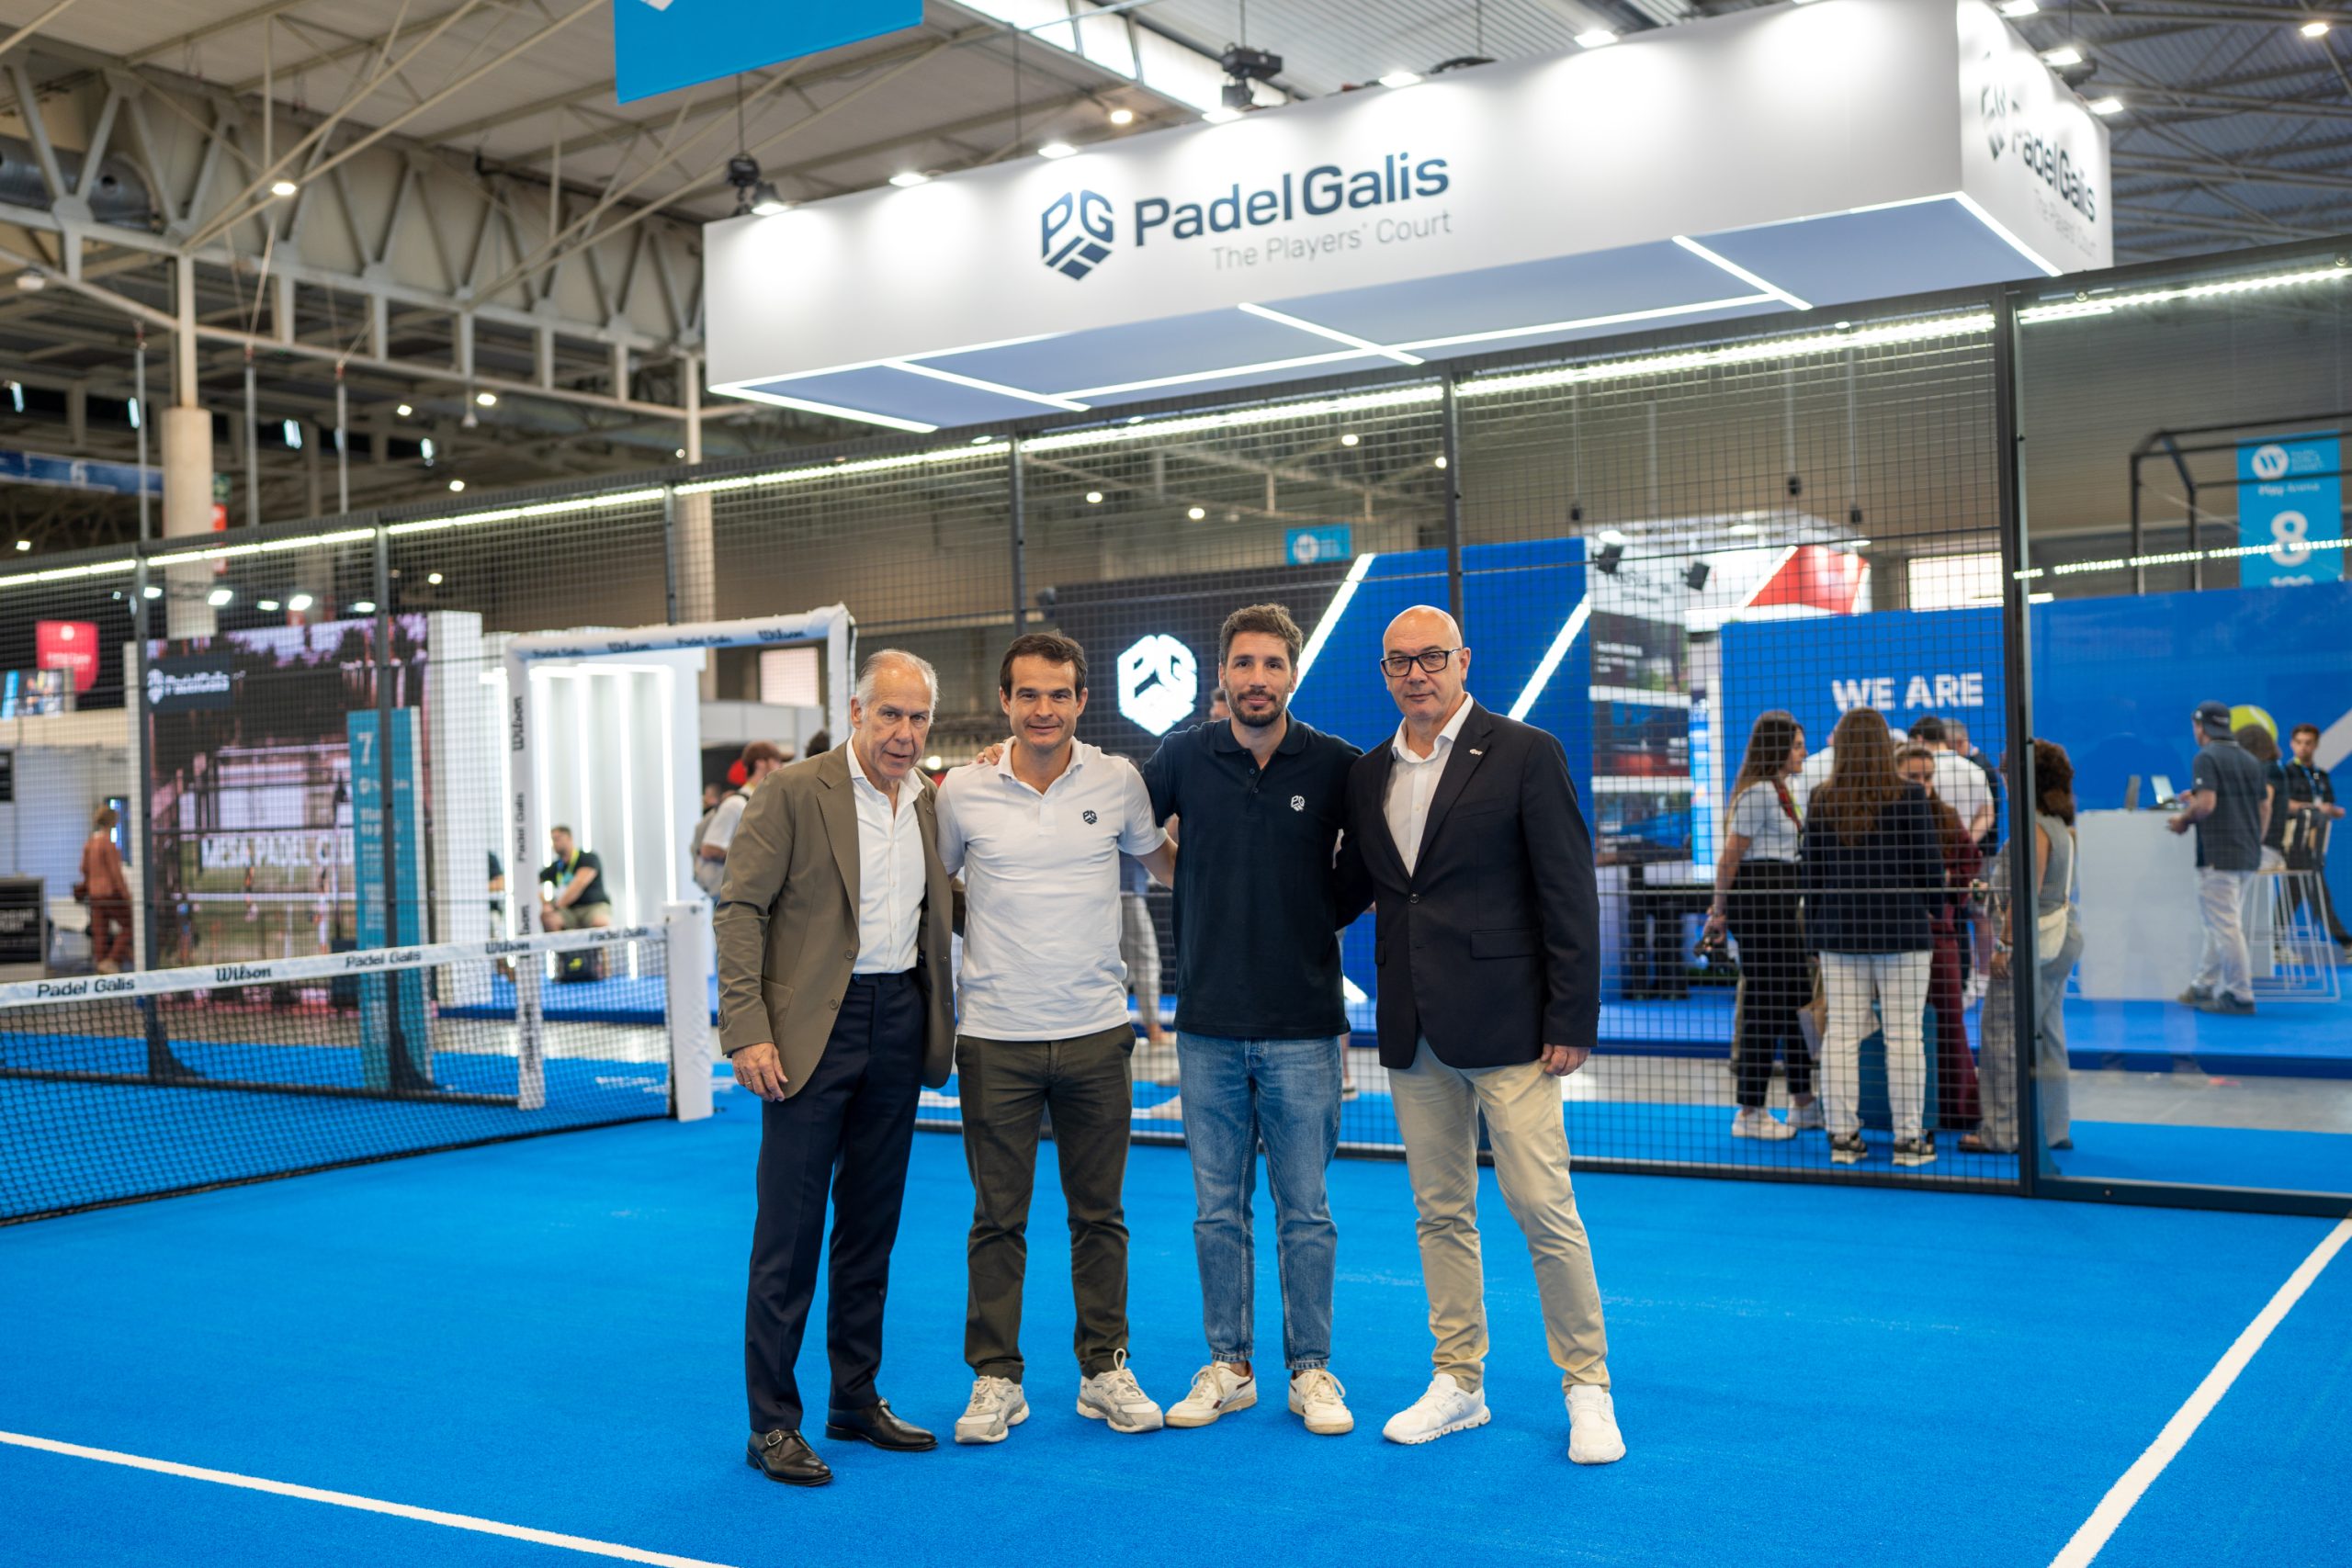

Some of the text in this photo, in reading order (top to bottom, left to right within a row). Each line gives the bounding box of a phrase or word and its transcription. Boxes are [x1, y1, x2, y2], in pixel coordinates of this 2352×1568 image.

[1211, 210, 1453, 271] The Players' Court
[2270, 510, 2312, 567] 8
[1831, 671, 1984, 713] WE ARE
[356, 731, 374, 765] 7
[38, 980, 87, 998] Padel
[94, 977, 136, 994] Galis
[215, 964, 273, 983] Wilson
[345, 953, 386, 968] Padel
